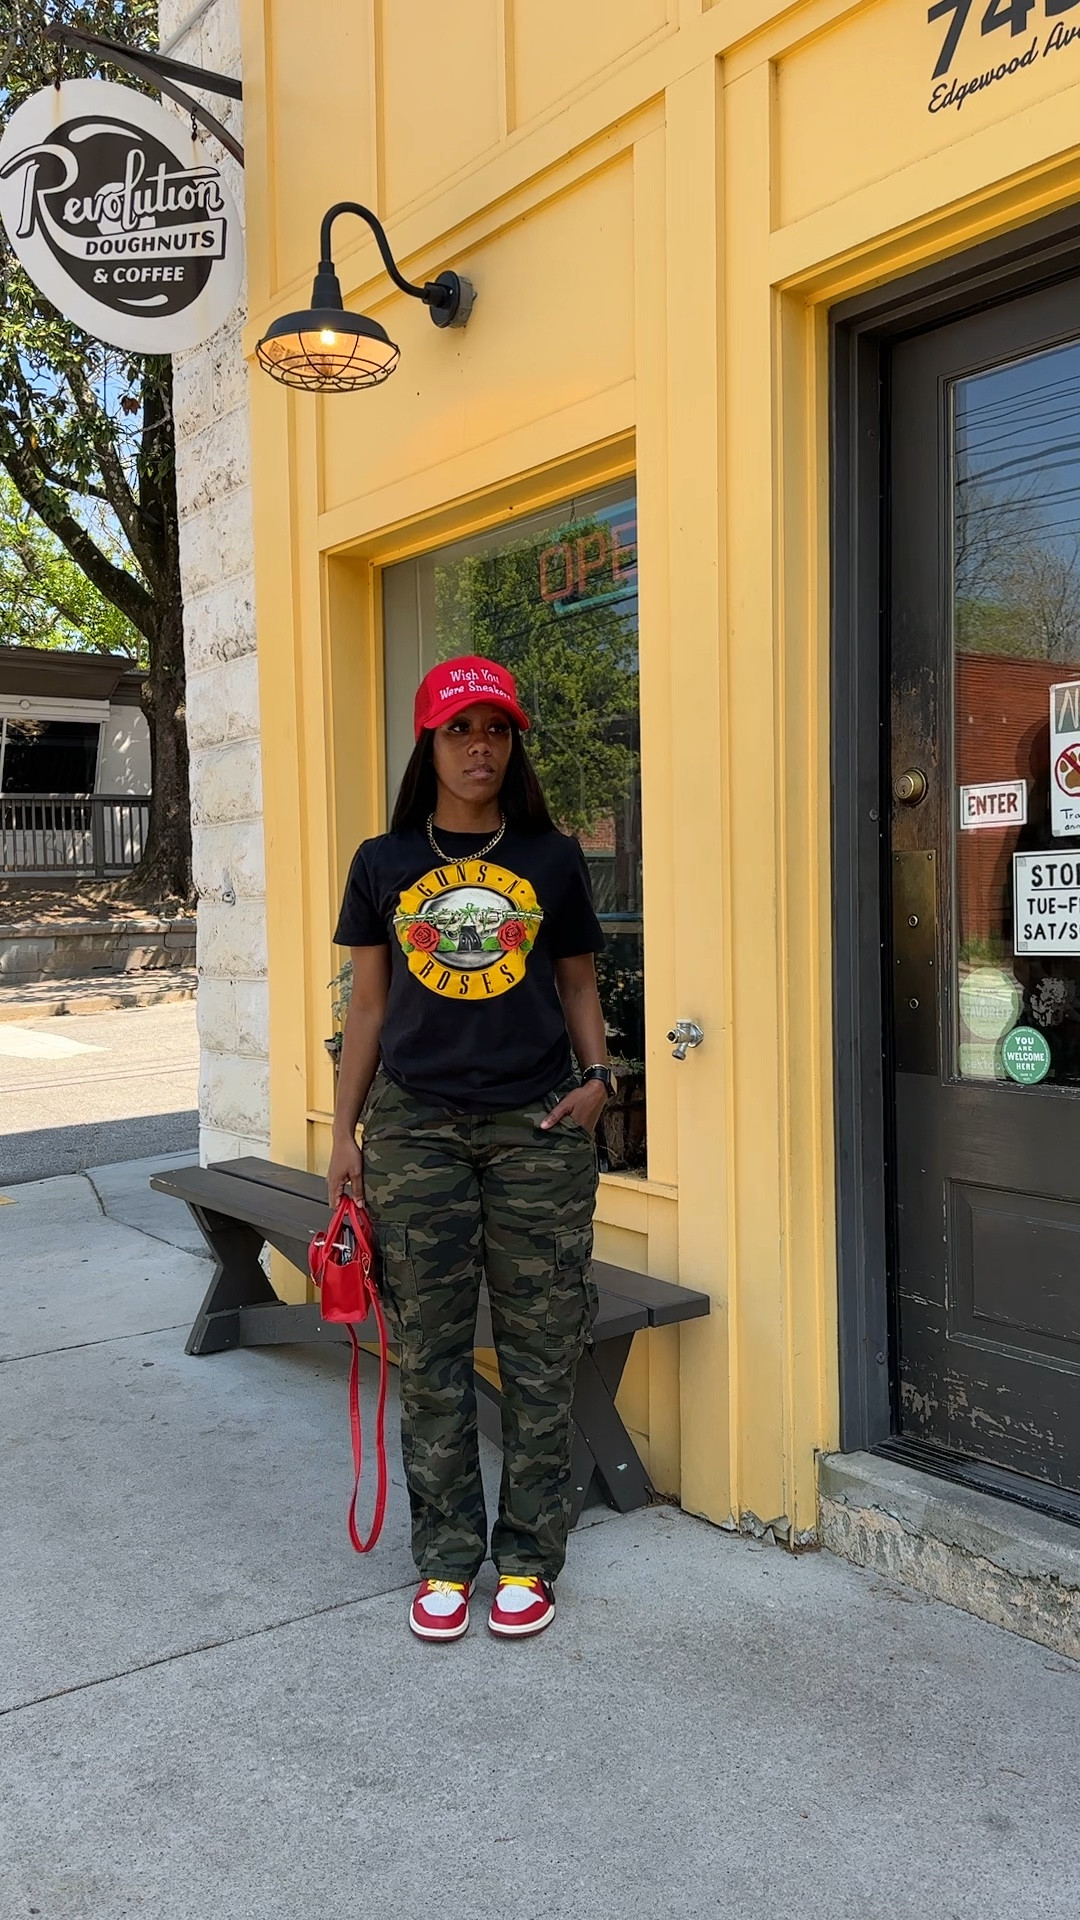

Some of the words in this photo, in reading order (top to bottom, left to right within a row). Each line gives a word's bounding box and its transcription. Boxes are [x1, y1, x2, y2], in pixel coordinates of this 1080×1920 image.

[928, 0, 1080, 81] 74
[928, 36, 1039, 113] Edgewood
[0, 143, 225, 239] Revolution
[85, 229, 215, 255] DOUGHNUTS
[93, 267, 108, 283] &
[112, 265, 184, 283] COFFEE
[538, 520, 637, 603] OPE
[450, 669, 479, 682] Wish
[481, 669, 500, 684] You
[439, 685, 465, 700] Were
[968, 793, 1018, 816] ENTER
[417, 864, 488, 897] GUNS
[1027, 896, 1080, 915] TUE-F
[1024, 922, 1080, 940] SAT/S
[419, 959, 516, 995] ROSES
[1015, 1036, 1034, 1045] YOU
[1006, 1051, 1045, 1062] WELCOME
[1016, 1062, 1035, 1071] HERE
